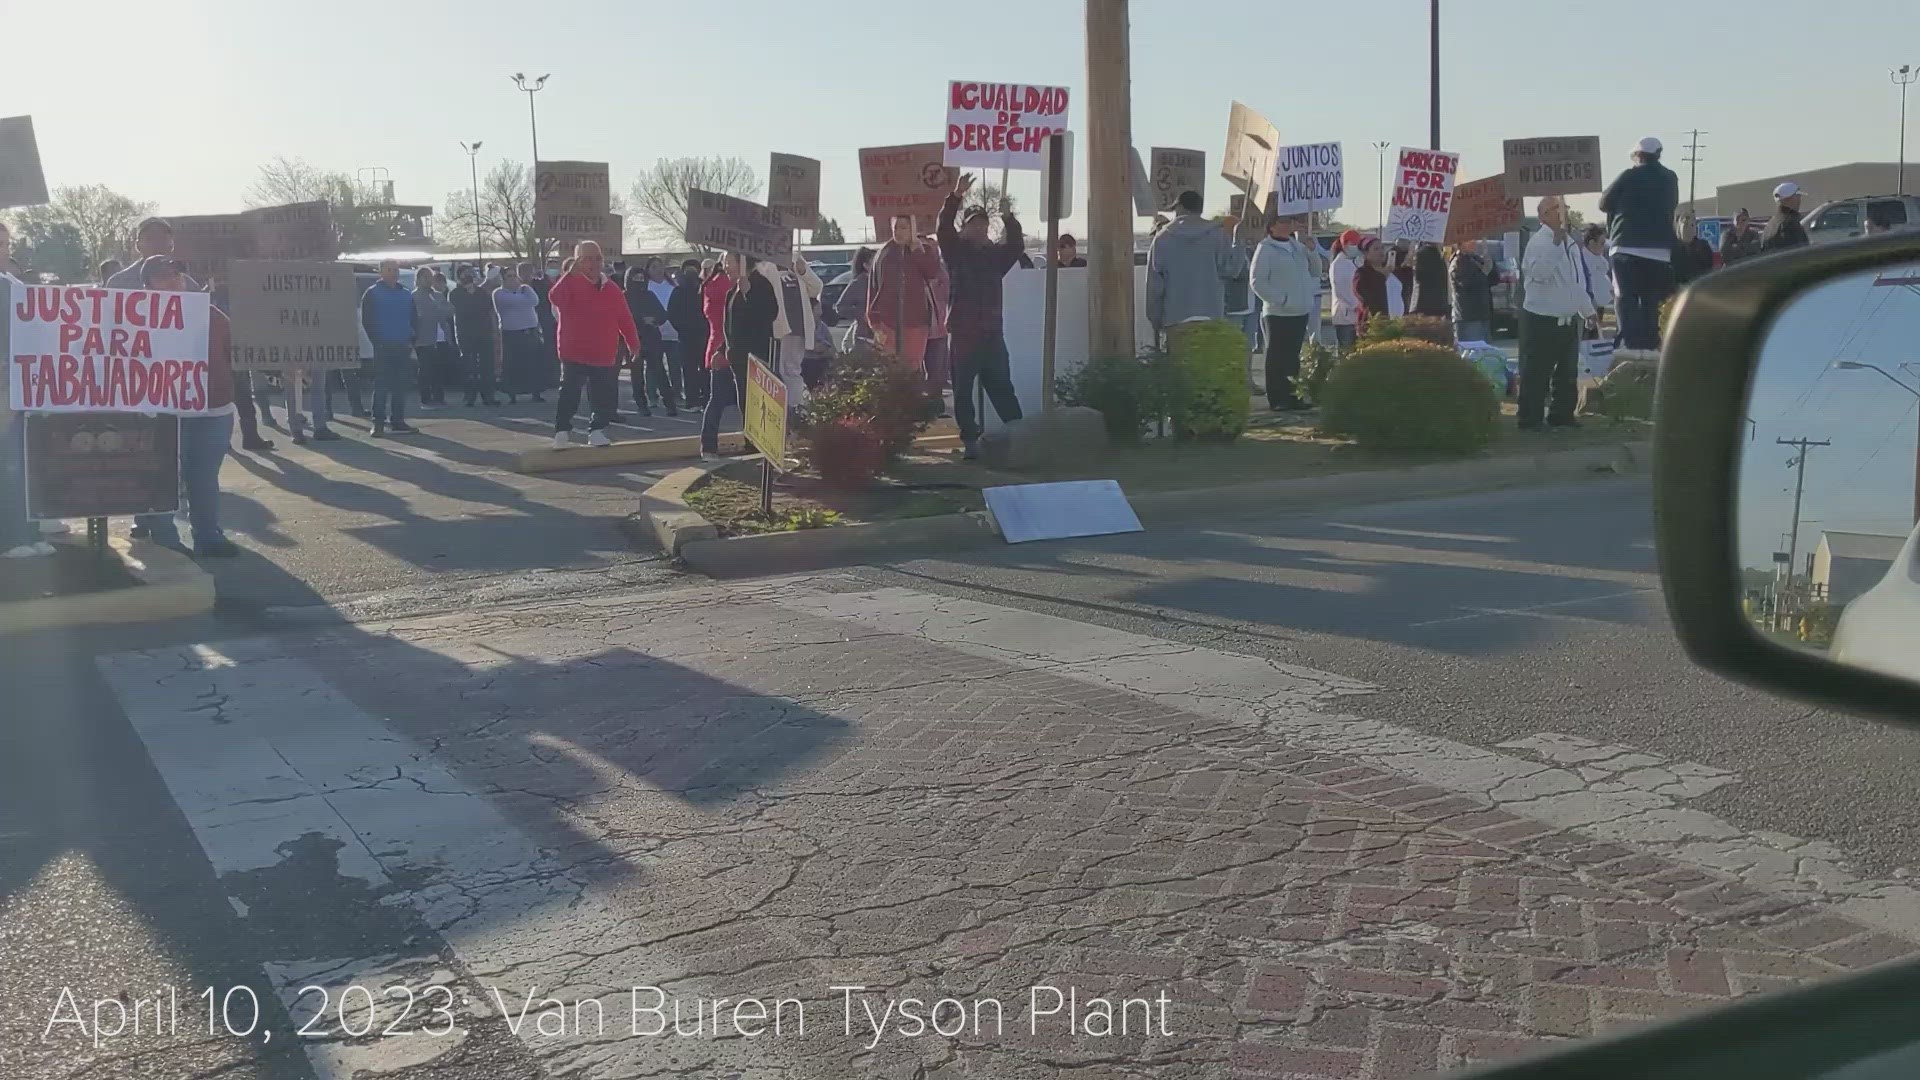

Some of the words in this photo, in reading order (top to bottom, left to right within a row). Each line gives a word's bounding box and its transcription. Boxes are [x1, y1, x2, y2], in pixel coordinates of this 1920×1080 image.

[952, 82, 1069, 116] IGUALDAD
[997, 111, 1021, 126] DE
[948, 123, 1067, 153] DERECH
[1281, 144, 1339, 172] JUNTOS
[1400, 150, 1458, 175] WORKERS
[1403, 170, 1445, 189] FOR
[1519, 162, 1593, 182] WORKERS
[1280, 170, 1341, 204] VENCEREMOS
[1392, 186, 1451, 213] JUSTICE
[704, 225, 774, 256] JUSTICE
[262, 272, 332, 292] JUSTICIA
[16, 287, 184, 330] JUSTICIA
[280, 307, 321, 328] PARA
[60, 323, 152, 358] PARA
[230, 345, 360, 363] TRABAJADORES
[755, 367, 779, 398] STOP
